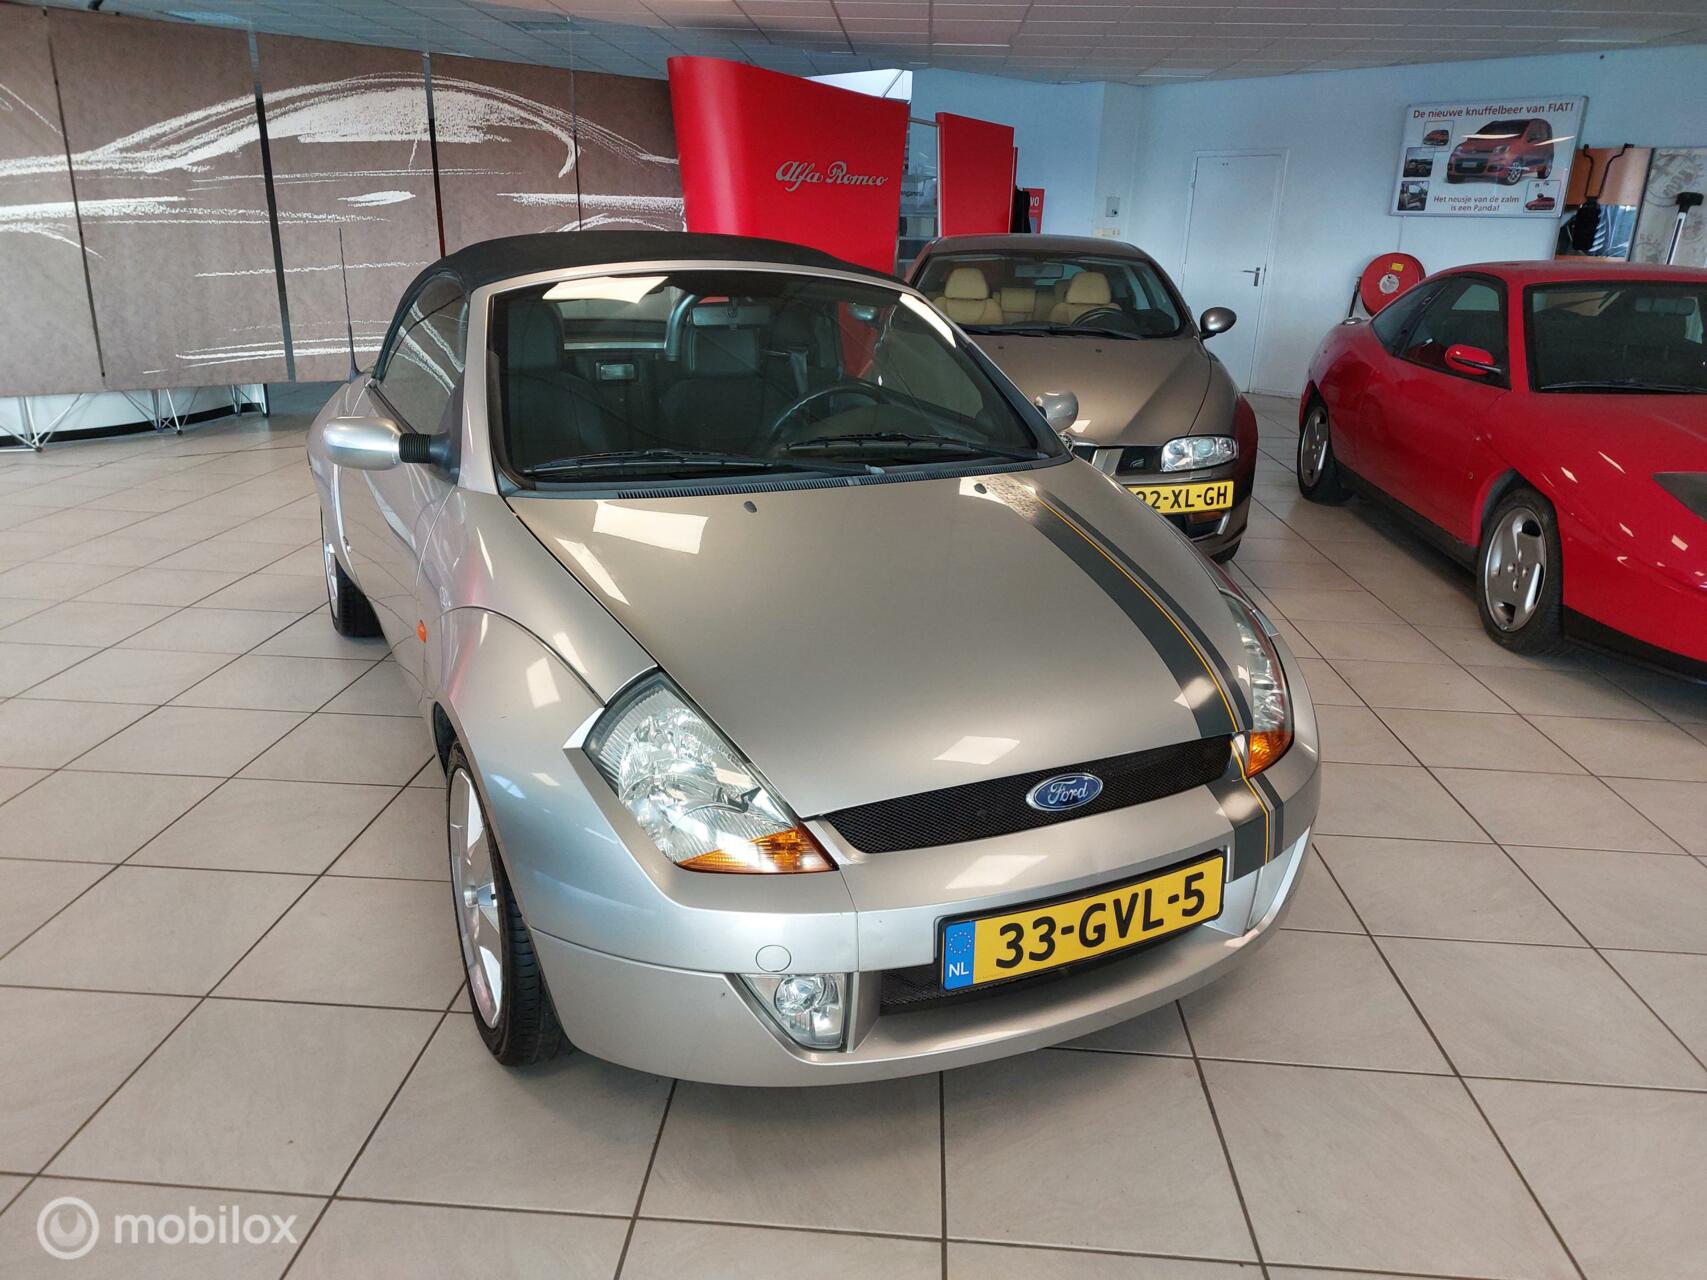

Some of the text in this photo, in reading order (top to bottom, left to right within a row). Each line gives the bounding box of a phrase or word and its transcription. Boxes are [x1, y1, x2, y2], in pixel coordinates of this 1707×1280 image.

[1413, 102, 1575, 118] De nieuwe knuffelbeer van FIAT!
[775, 160, 889, 192] Alfa Romeo
[1433, 195, 1447, 203] Het
[1489, 195, 1500, 203] de
[1501, 195, 1520, 203] zalm
[1047, 779, 1089, 804] Ford
[995, 871, 1205, 969] 33-GVL-5
[948, 961, 970, 978] NL
